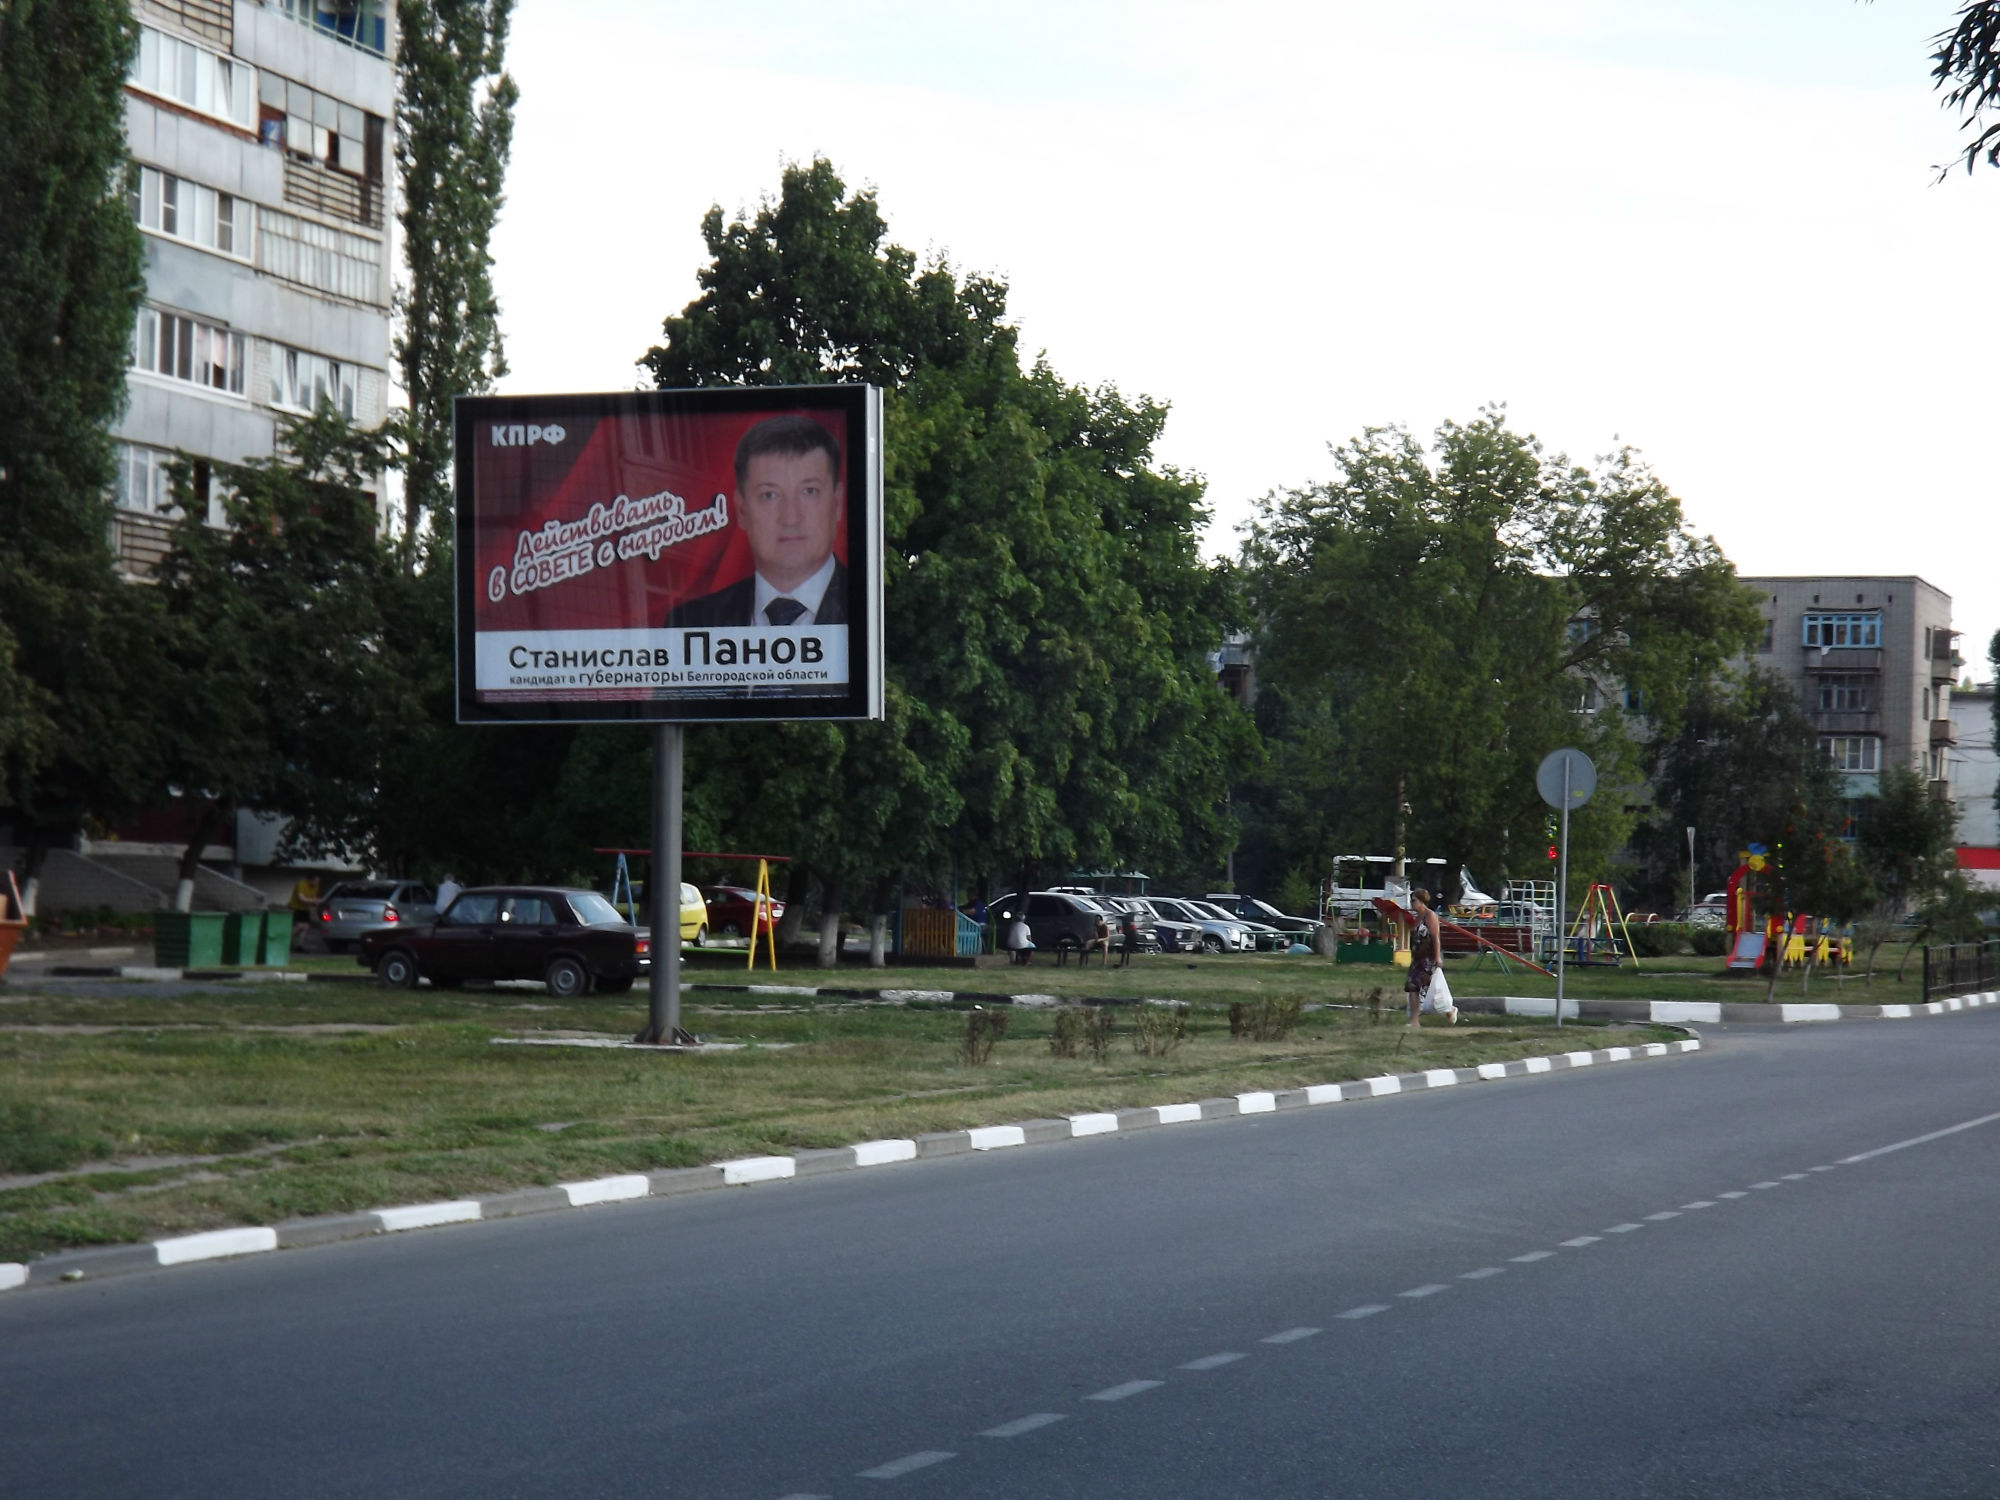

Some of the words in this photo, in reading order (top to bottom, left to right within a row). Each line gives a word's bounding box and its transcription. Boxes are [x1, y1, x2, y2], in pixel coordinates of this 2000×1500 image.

[491, 423, 566, 447] КПРФ
[490, 567, 505, 600] в
[512, 544, 593, 593] СОВЕТЕ
[598, 542, 614, 566] с
[618, 495, 727, 558] народом!
[514, 491, 683, 566] Действовать,
[509, 645, 669, 669] Станислав
[683, 631, 824, 666] Панов
[509, 675, 567, 686] кандидат
[569, 675, 576, 684] в
[579, 669, 683, 686] губернаторы
[687, 669, 775, 683] Белгородской
[777, 669, 828, 681] области
